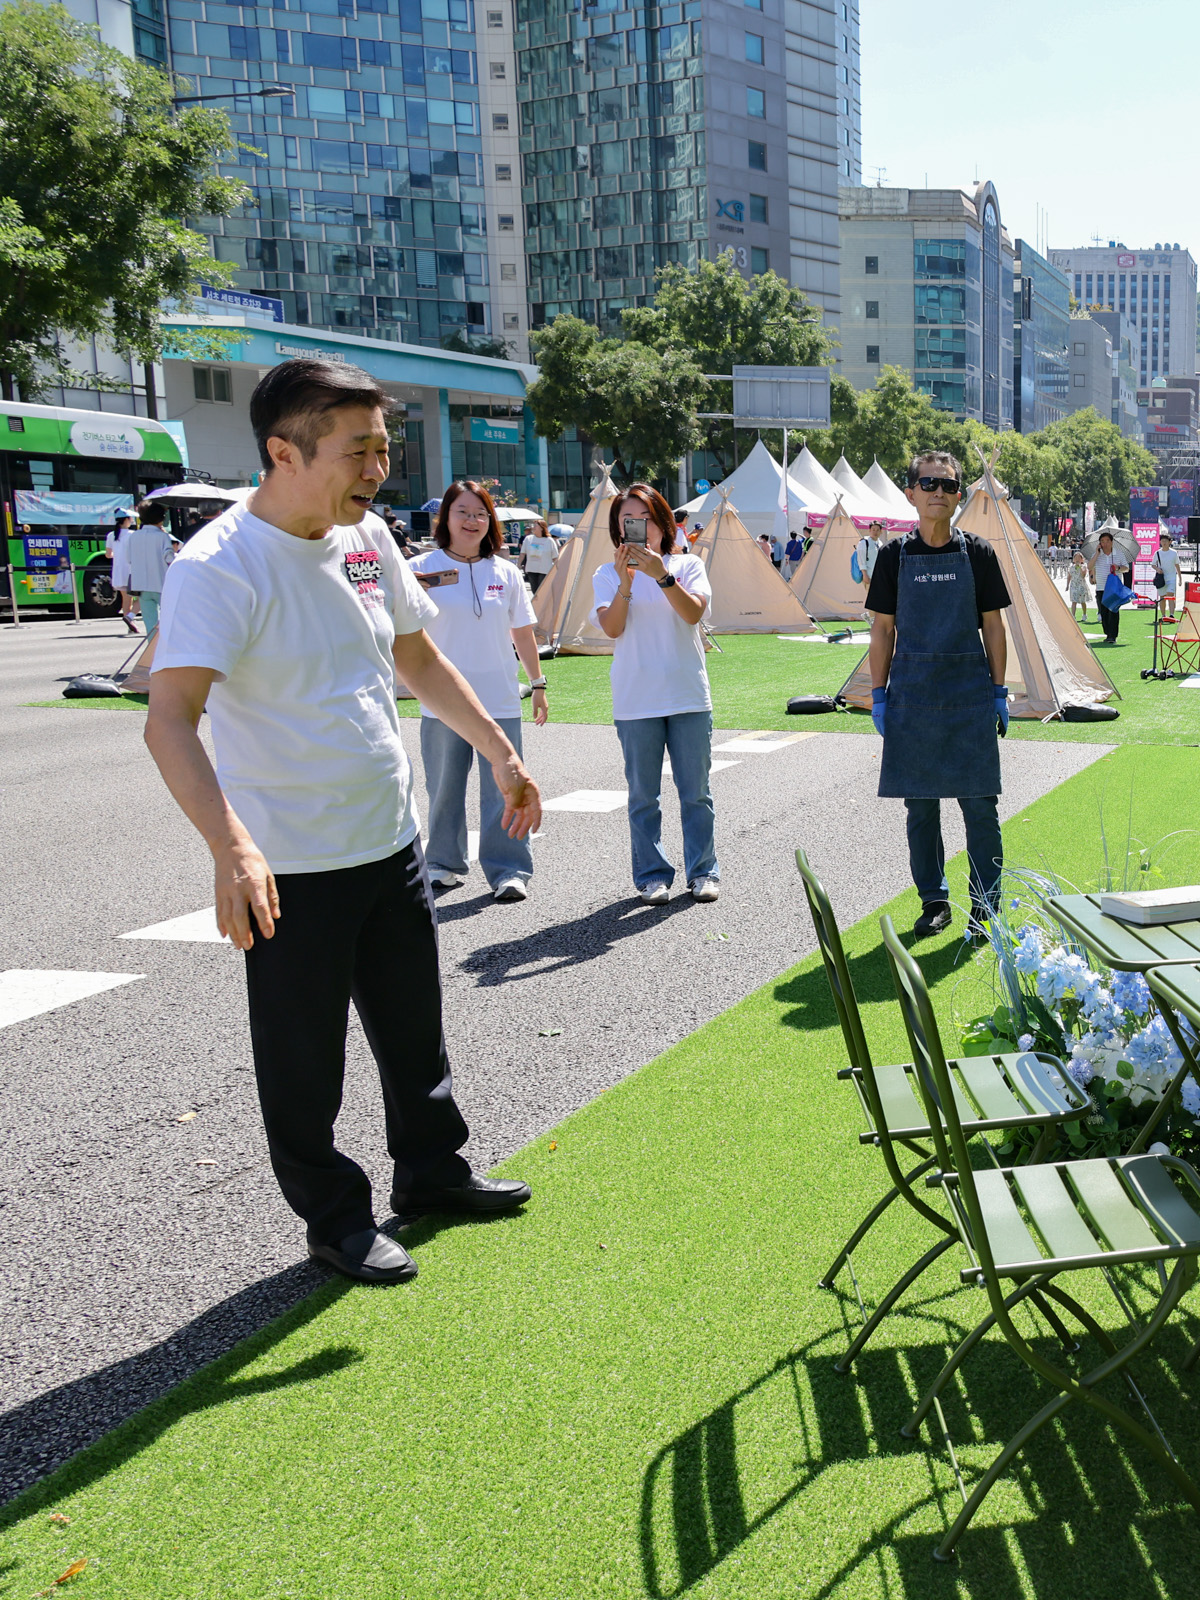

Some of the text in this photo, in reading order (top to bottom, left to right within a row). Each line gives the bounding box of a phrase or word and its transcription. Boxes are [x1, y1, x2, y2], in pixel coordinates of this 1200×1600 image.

[82, 431, 117, 442] 전기버스 타고
[494, 431, 507, 439] 주유소
[1136, 530, 1157, 539] SMF
[346, 560, 384, 582] 전성수
[914, 573, 957, 582] 서초 정원센터
